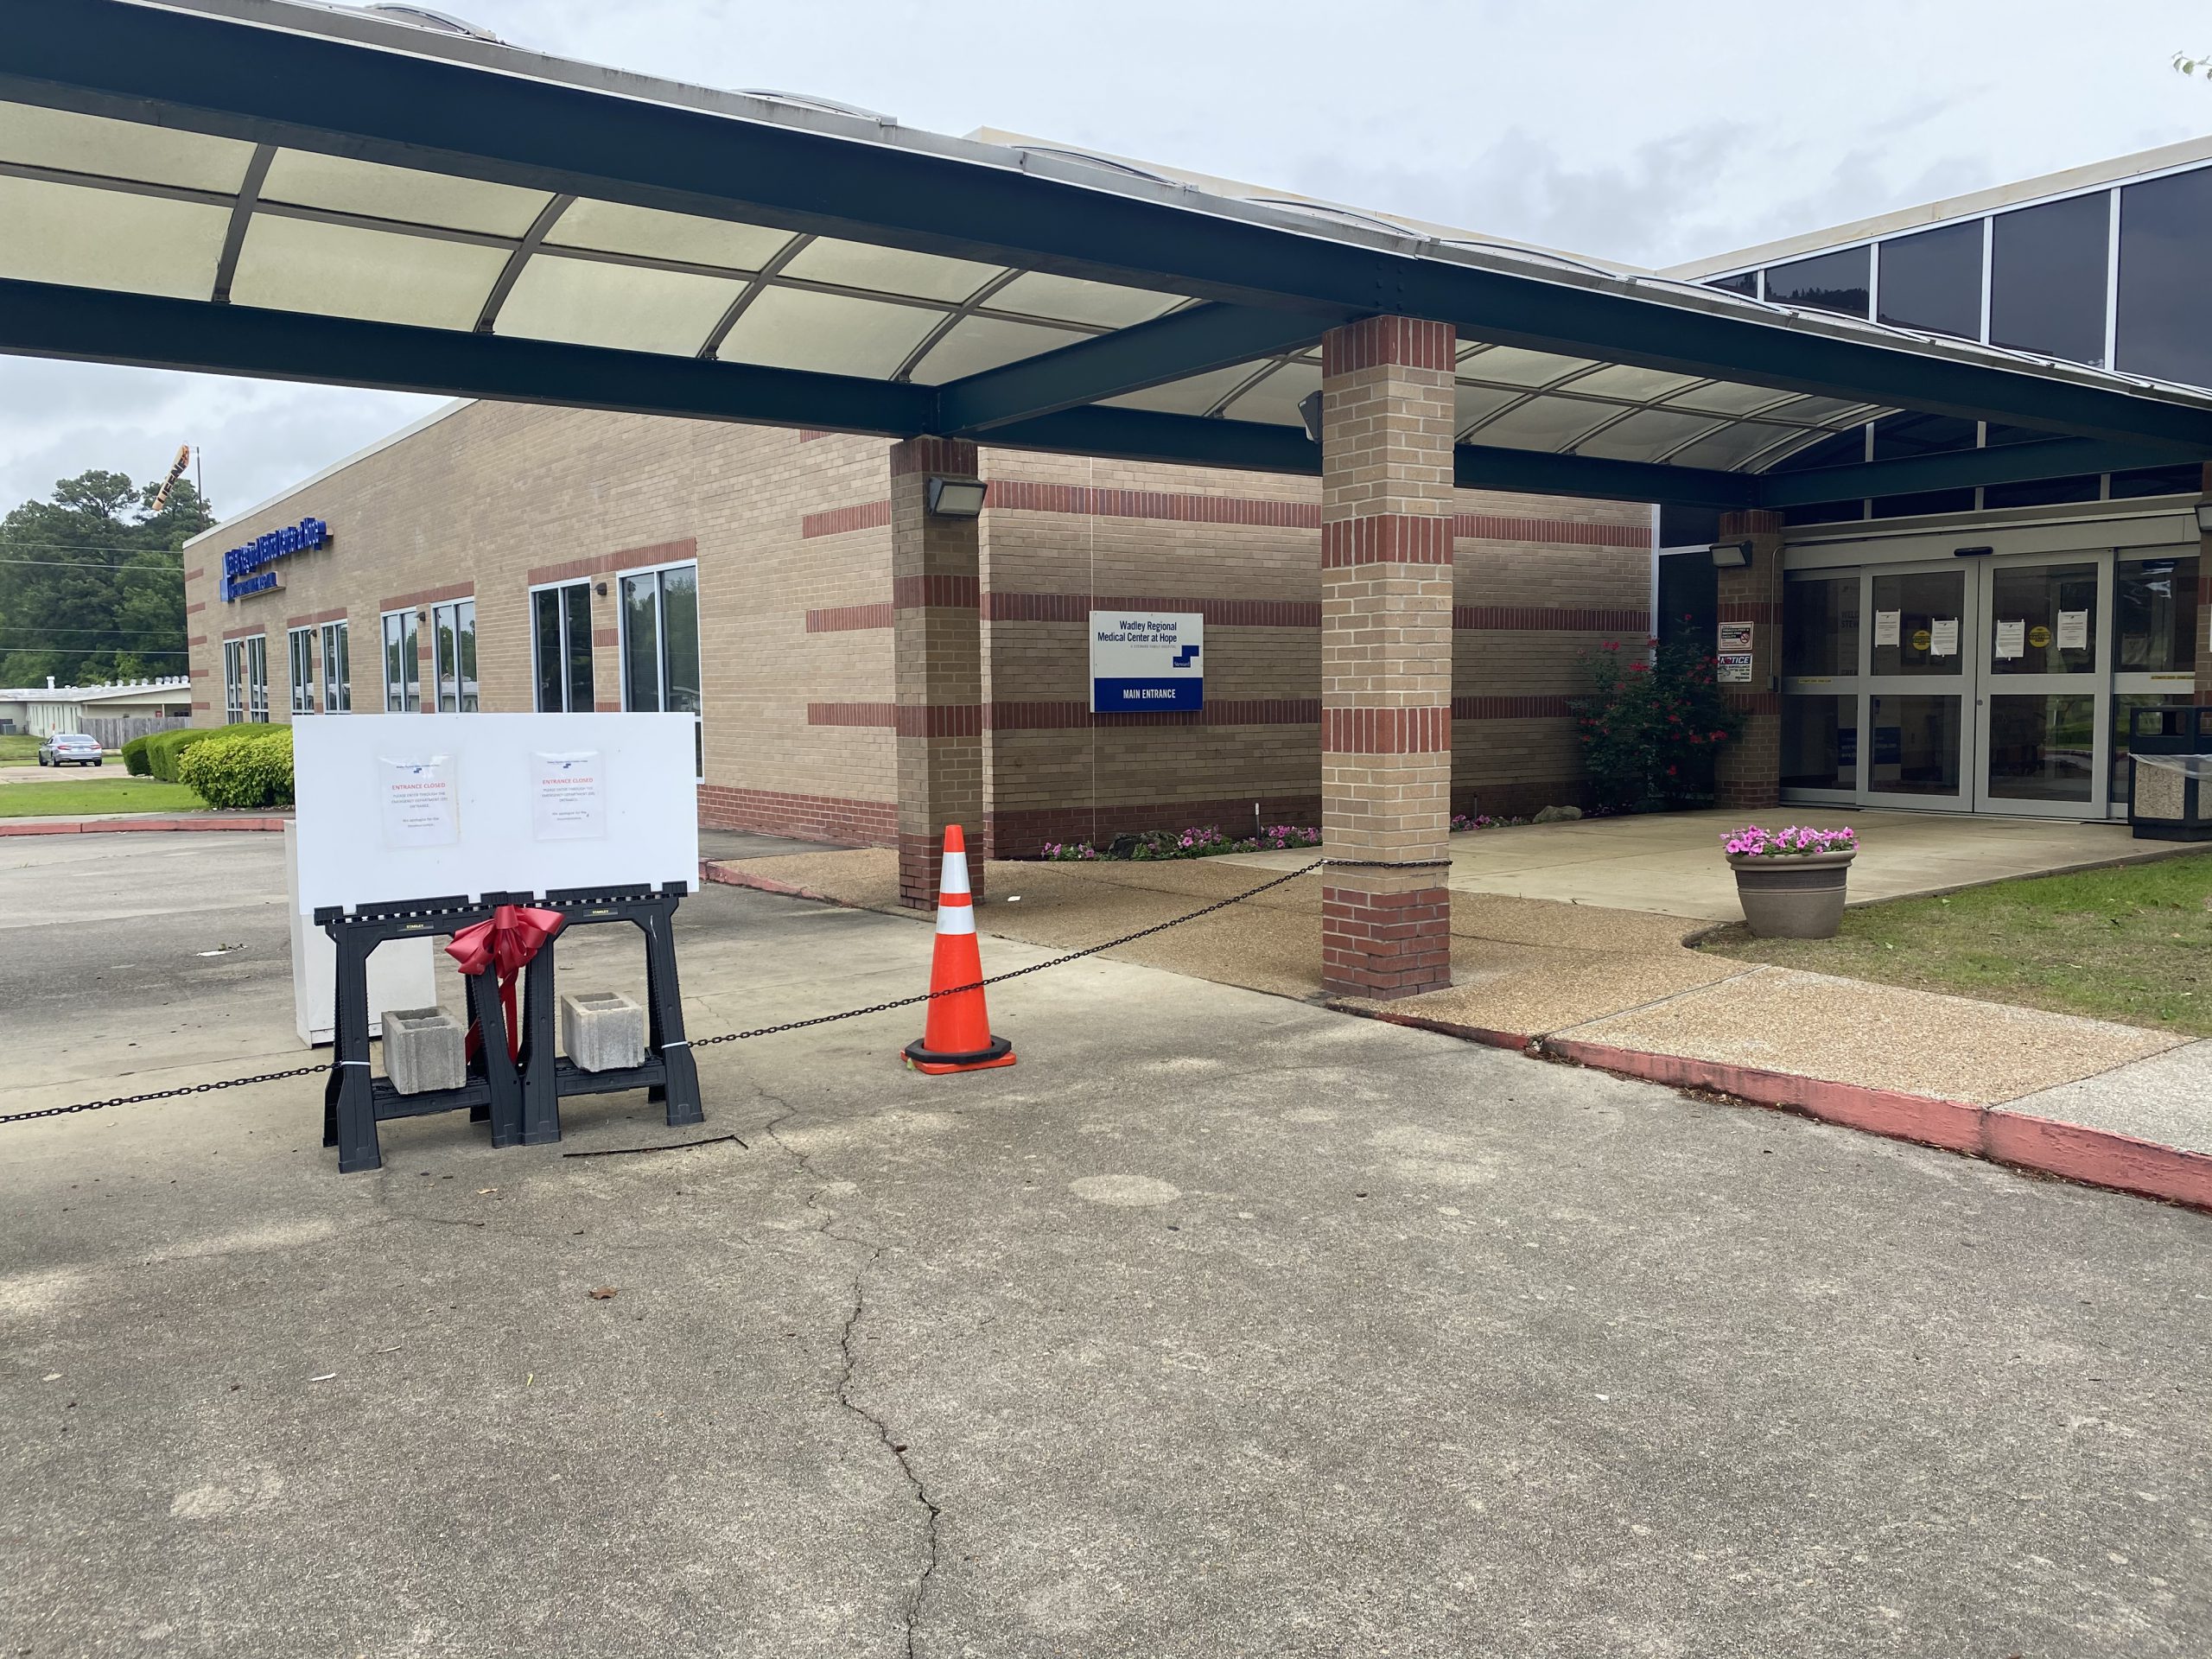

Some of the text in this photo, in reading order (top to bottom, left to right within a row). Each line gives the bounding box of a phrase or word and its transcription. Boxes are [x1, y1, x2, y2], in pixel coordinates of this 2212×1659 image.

[1120, 620, 1177, 632] Wadley Regional
[1097, 632, 1178, 645] Medical Center at Hope
[1123, 689, 1176, 699] MAIN ENTRANCE
